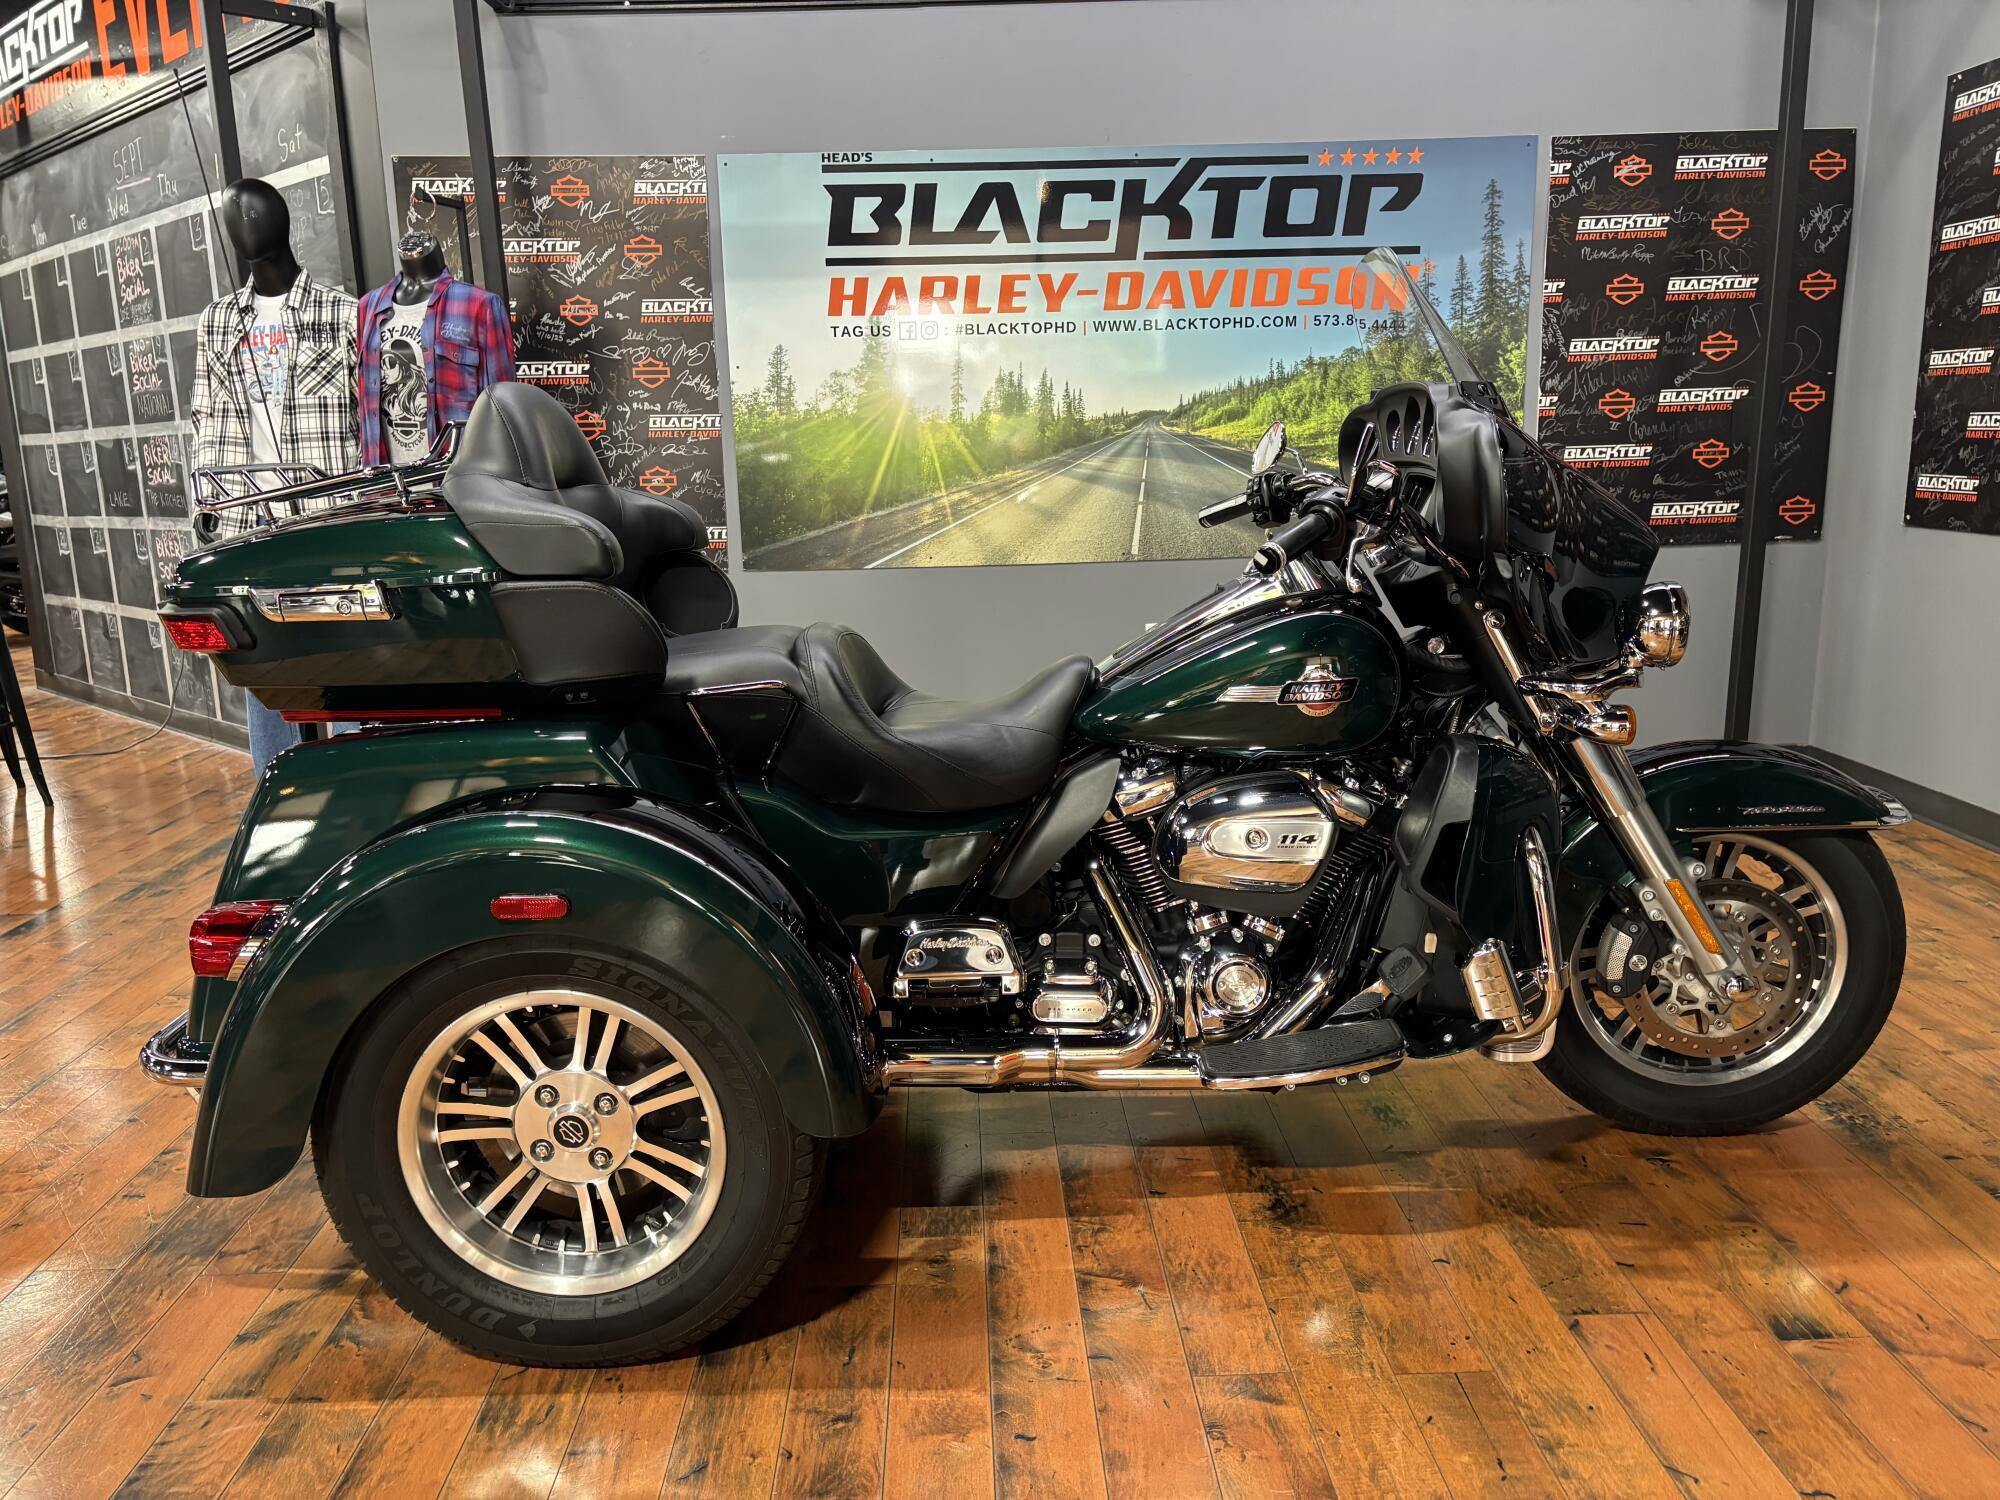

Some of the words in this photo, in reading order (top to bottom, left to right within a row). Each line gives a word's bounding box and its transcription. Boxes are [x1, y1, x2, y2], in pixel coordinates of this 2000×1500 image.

[113, 137, 143, 184] SEPT
[821, 152, 873, 163] HEAD'S
[1675, 153, 1769, 171] BLACKTOP
[107, 193, 129, 221] Wed
[277, 123, 303, 162] Sat
[1674, 170, 1766, 181] HARLEY-DAVIDSON
[823, 157, 1424, 260] BLACKTOP
[1577, 214, 1671, 231] BLACKTOP
[1575, 230, 1668, 241] HARLEY-DAVIDSON
[1666, 275, 1760, 292] BLACKTOP
[827, 267, 1422, 318] HARLEY-DAVIDSON
[1665, 291, 1757, 302] HARLEY-DAVIDSON
[830, 325, 864, 338] TAG
[870, 324, 892, 337] US
[955, 321, 1077, 337] #BLACKTOPHD
[1093, 316, 1298, 333] WWW.BLACKTOPHD.COM
[1568, 338, 1660, 354] BLACKTOP
[1567, 353, 1658, 362] HARLEY-DAVIDSON
[1929, 349, 1995, 366] BLACKTOP
[1928, 365, 1991, 377] HARLEY-DAVIDSON
[1658, 387, 1750, 404] BLACKTOP
[1563, 444, 1654, 461] BLACKTOP
[1567, 459, 1650, 470] ARLEY-DAVIDSON
[1917, 475, 1980, 492] BLACKTOP
[109, 490, 132, 508] LAKE
[1915, 491, 1977, 503] HARLEY-DAVIDSON
[1650, 501, 1741, 518] BLACKTOP
[1648, 516, 1737, 526] HARLEY-DAVIDSON
[1290, 682, 1344, 694] HARLEY
[1280, 833, 1319, 845] 114
[356, 1192, 507, 1330] DUNLOP
